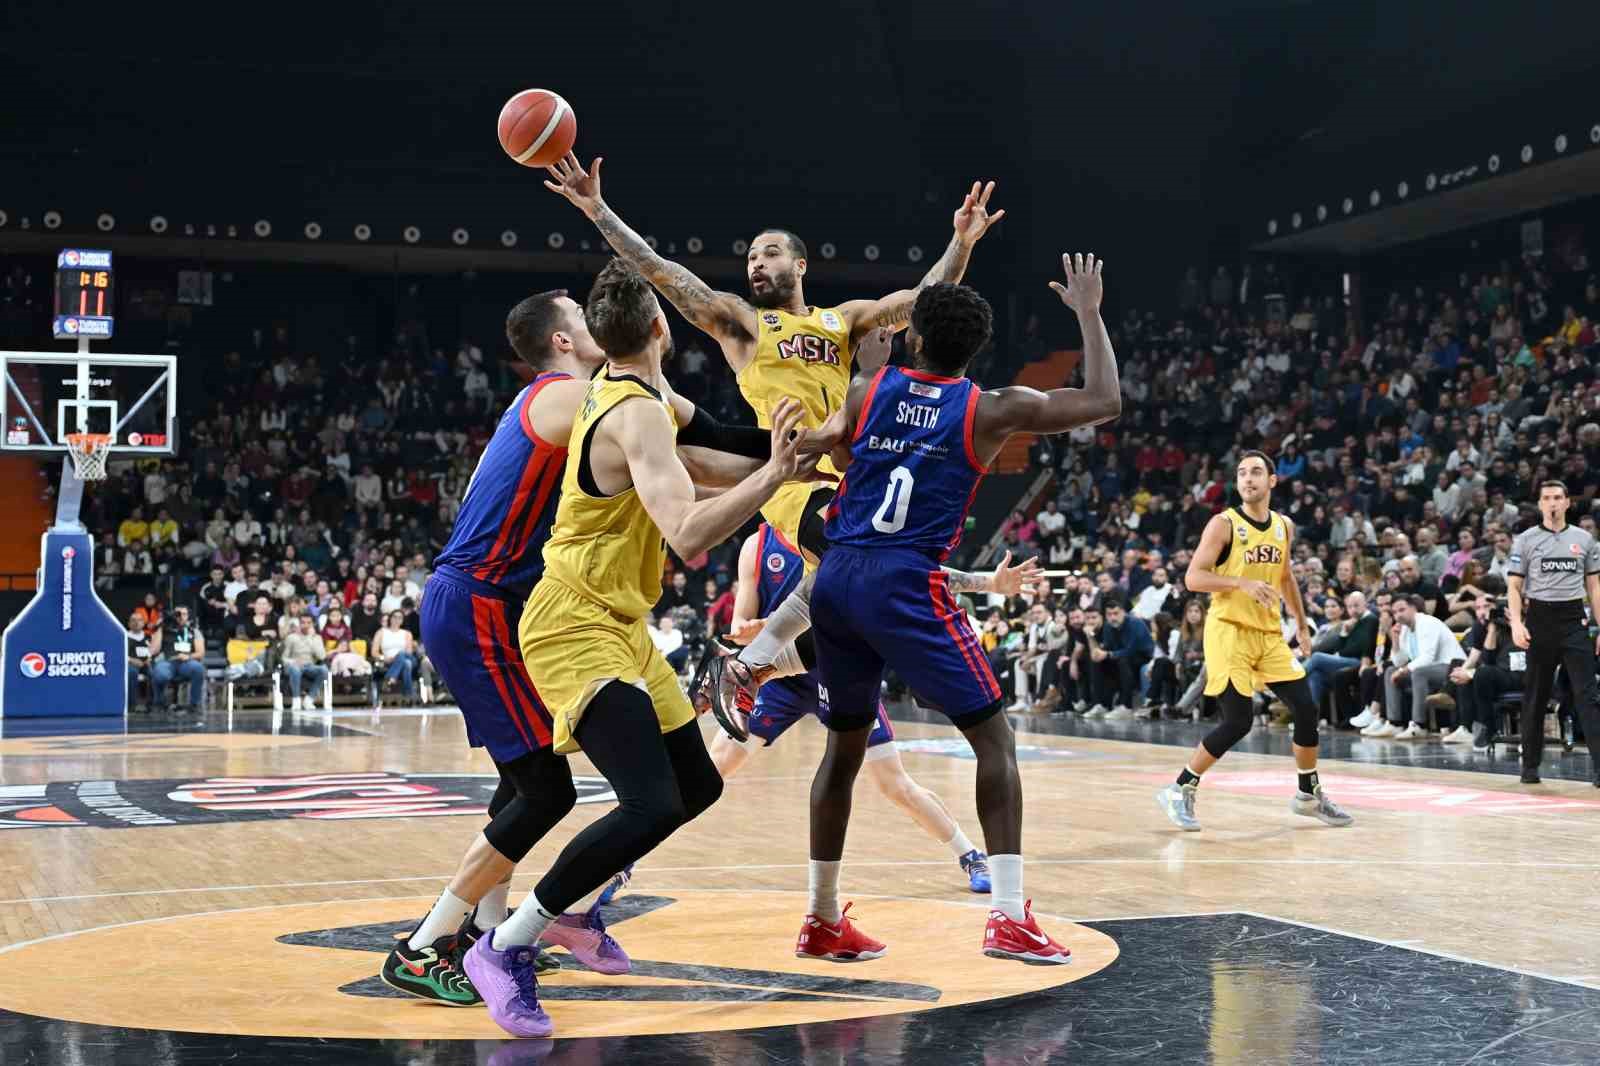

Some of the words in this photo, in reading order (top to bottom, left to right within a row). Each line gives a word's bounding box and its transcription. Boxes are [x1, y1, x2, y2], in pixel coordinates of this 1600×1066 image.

[777, 334, 840, 366] MSK
[896, 401, 940, 429] SMITH
[868, 435, 905, 453] BAU
[872, 466, 914, 534] 0
[1245, 545, 1281, 564] MSK
